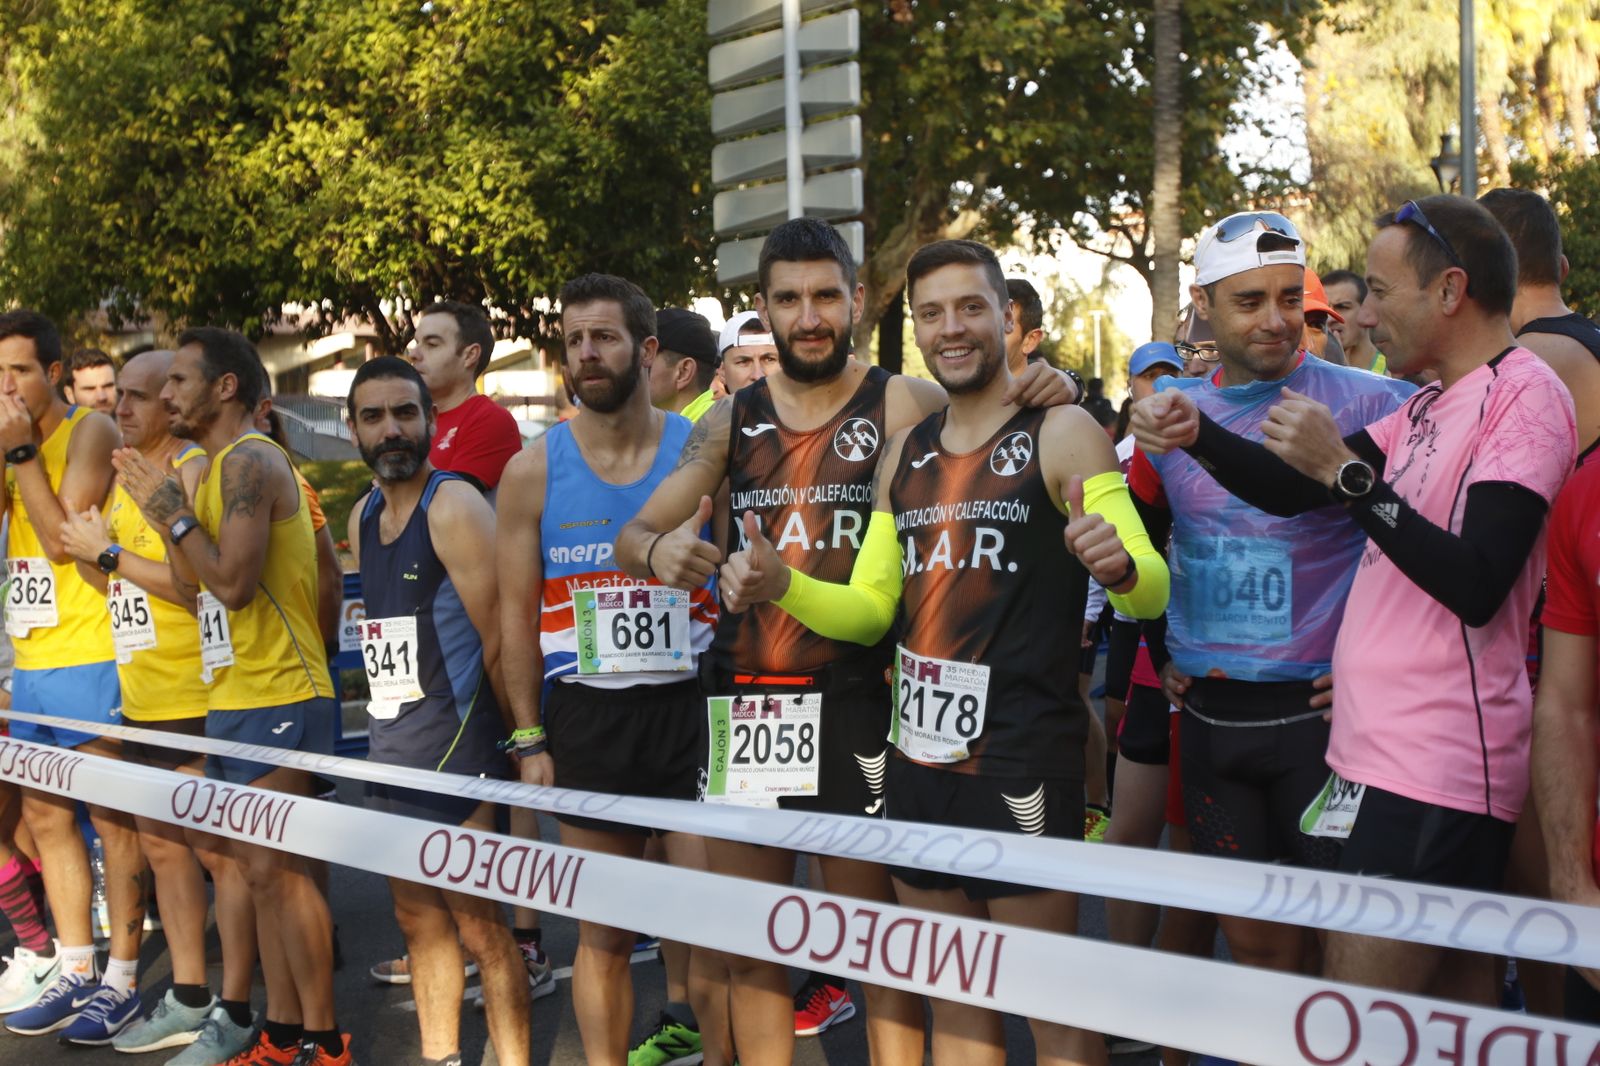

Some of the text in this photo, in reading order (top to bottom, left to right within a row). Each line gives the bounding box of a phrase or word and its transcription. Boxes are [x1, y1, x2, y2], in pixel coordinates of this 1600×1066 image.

[800, 487, 808, 505] Y
[948, 503, 956, 522] Y
[955, 499, 1030, 524] CALEFACCIÓN
[1371, 504, 1397, 529] adidas
[12, 577, 52, 604] 362
[110, 597, 149, 629] 345
[199, 608, 225, 643] 41
[611, 611, 672, 650] 681
[365, 641, 410, 679] 341
[946, 665, 987, 678] 35 MEDIA
[900, 678, 979, 738] 2178
[716, 730, 726, 773] CAJÓN
[731, 722, 815, 764] 2058
[0, 740, 85, 792] IMDEC
[170, 779, 297, 843] IMDECO
[418, 828, 586, 909] IMDECO
[766, 894, 1007, 999] IMDECO
